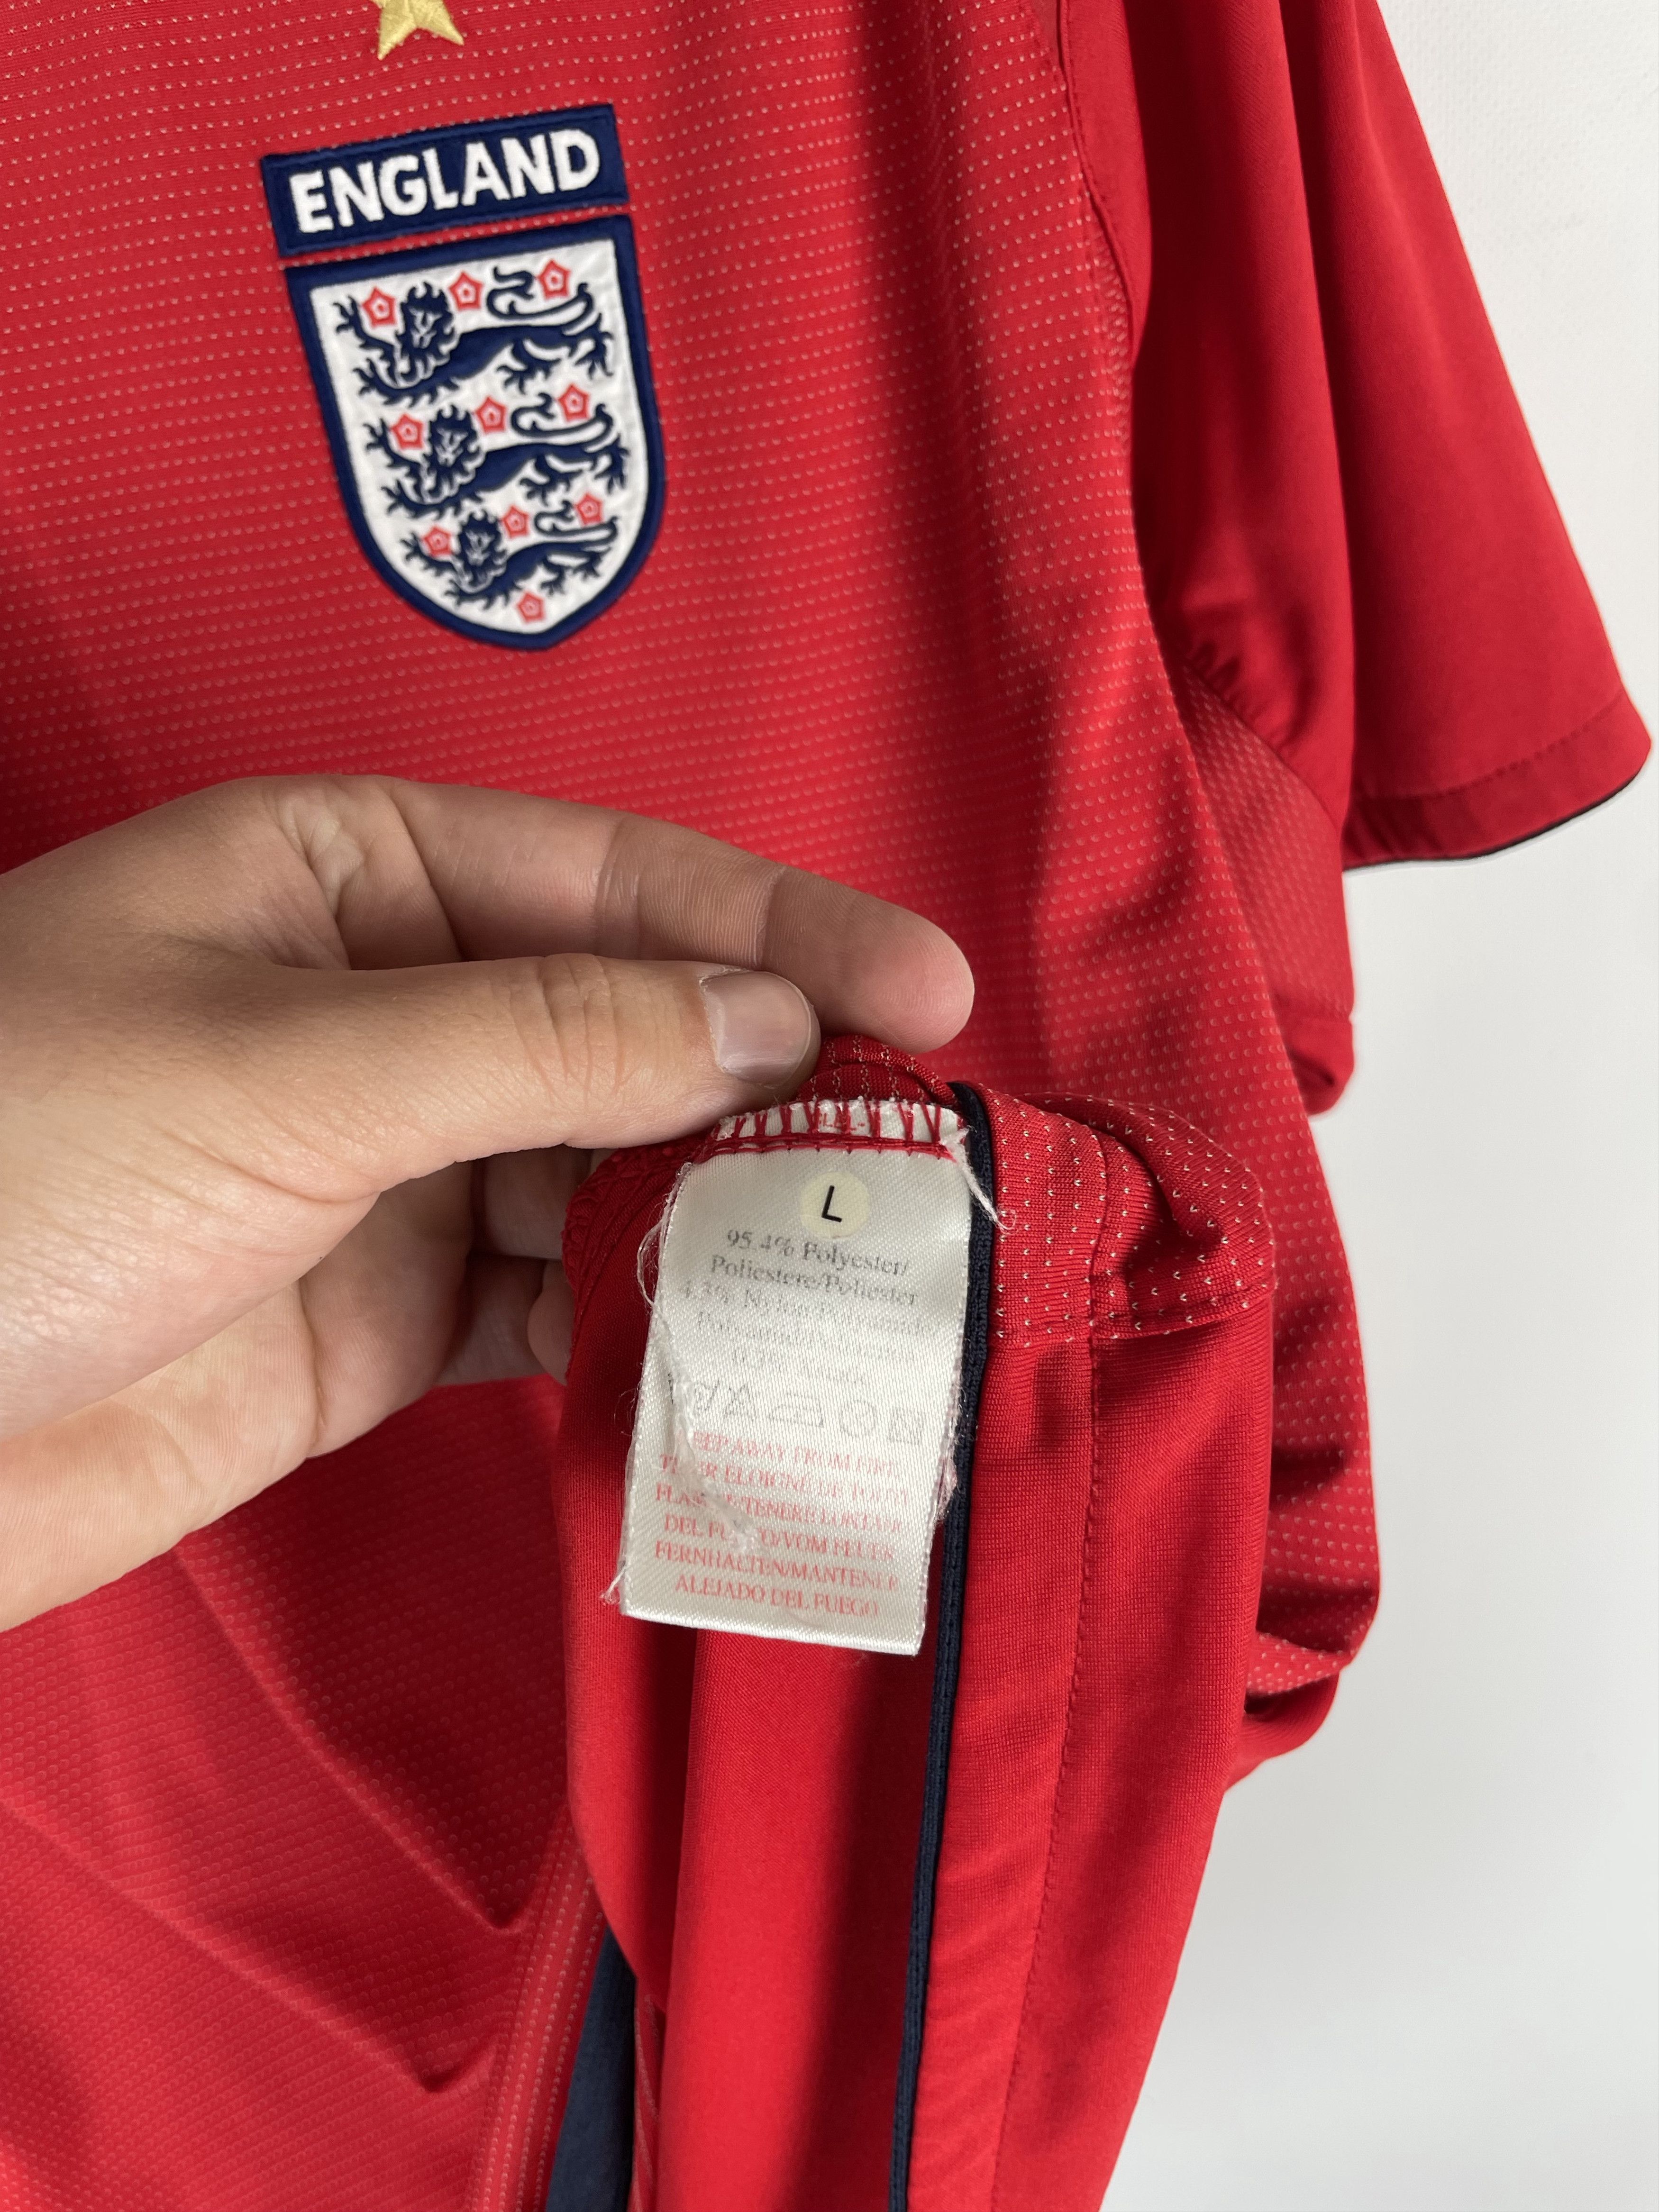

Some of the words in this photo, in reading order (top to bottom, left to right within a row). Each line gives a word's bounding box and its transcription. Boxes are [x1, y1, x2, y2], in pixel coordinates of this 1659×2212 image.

[290, 128, 600, 233] ENGLAND
[821, 1185, 842, 1223] L
[665, 1513, 704, 1537] DEL
[675, 1574, 766, 1603] ALEJADO
[770, 1588, 810, 1609] DEL
[814, 1592, 879, 1617] FUEGO
